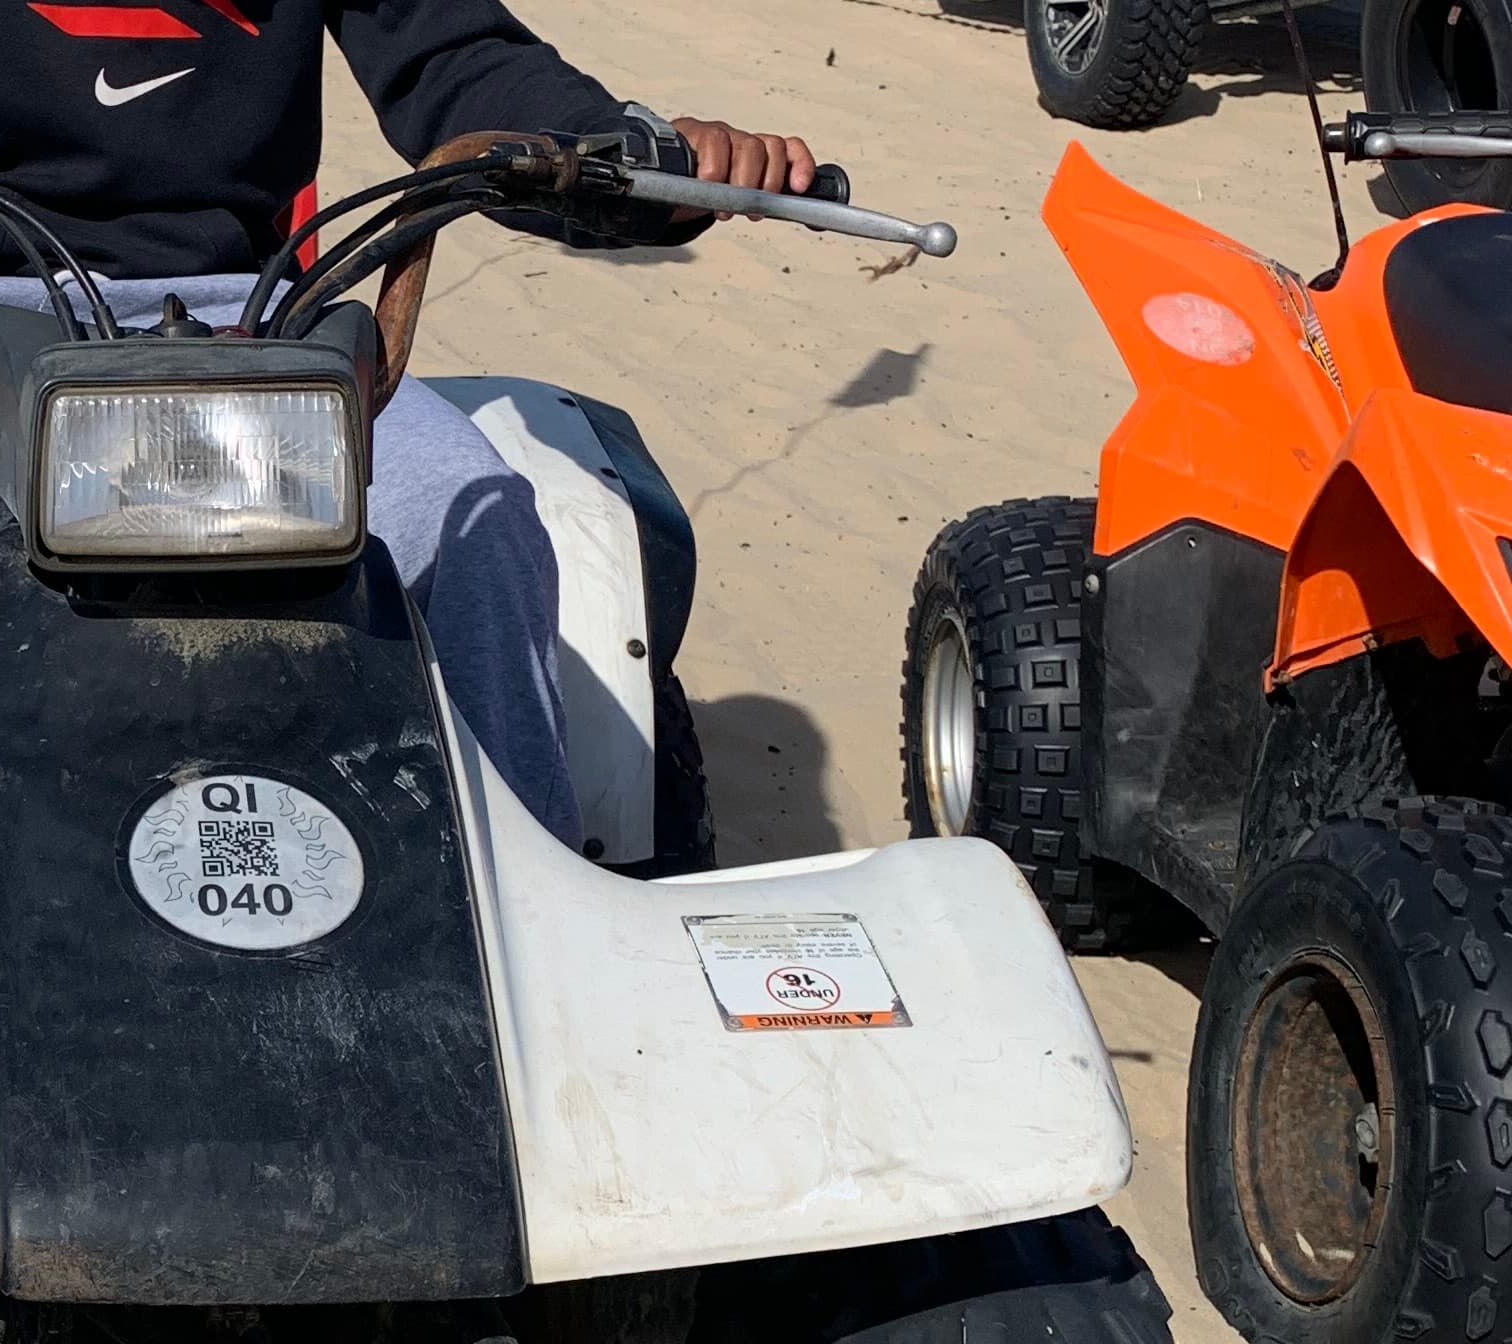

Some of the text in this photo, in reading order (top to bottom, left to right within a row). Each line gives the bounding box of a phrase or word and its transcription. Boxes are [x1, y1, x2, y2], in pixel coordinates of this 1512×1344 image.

[197, 883, 293, 916] 040
[783, 973, 816, 986] 16
[777, 989, 835, 999] UNDER
[758, 1014, 852, 1026] WARNING
